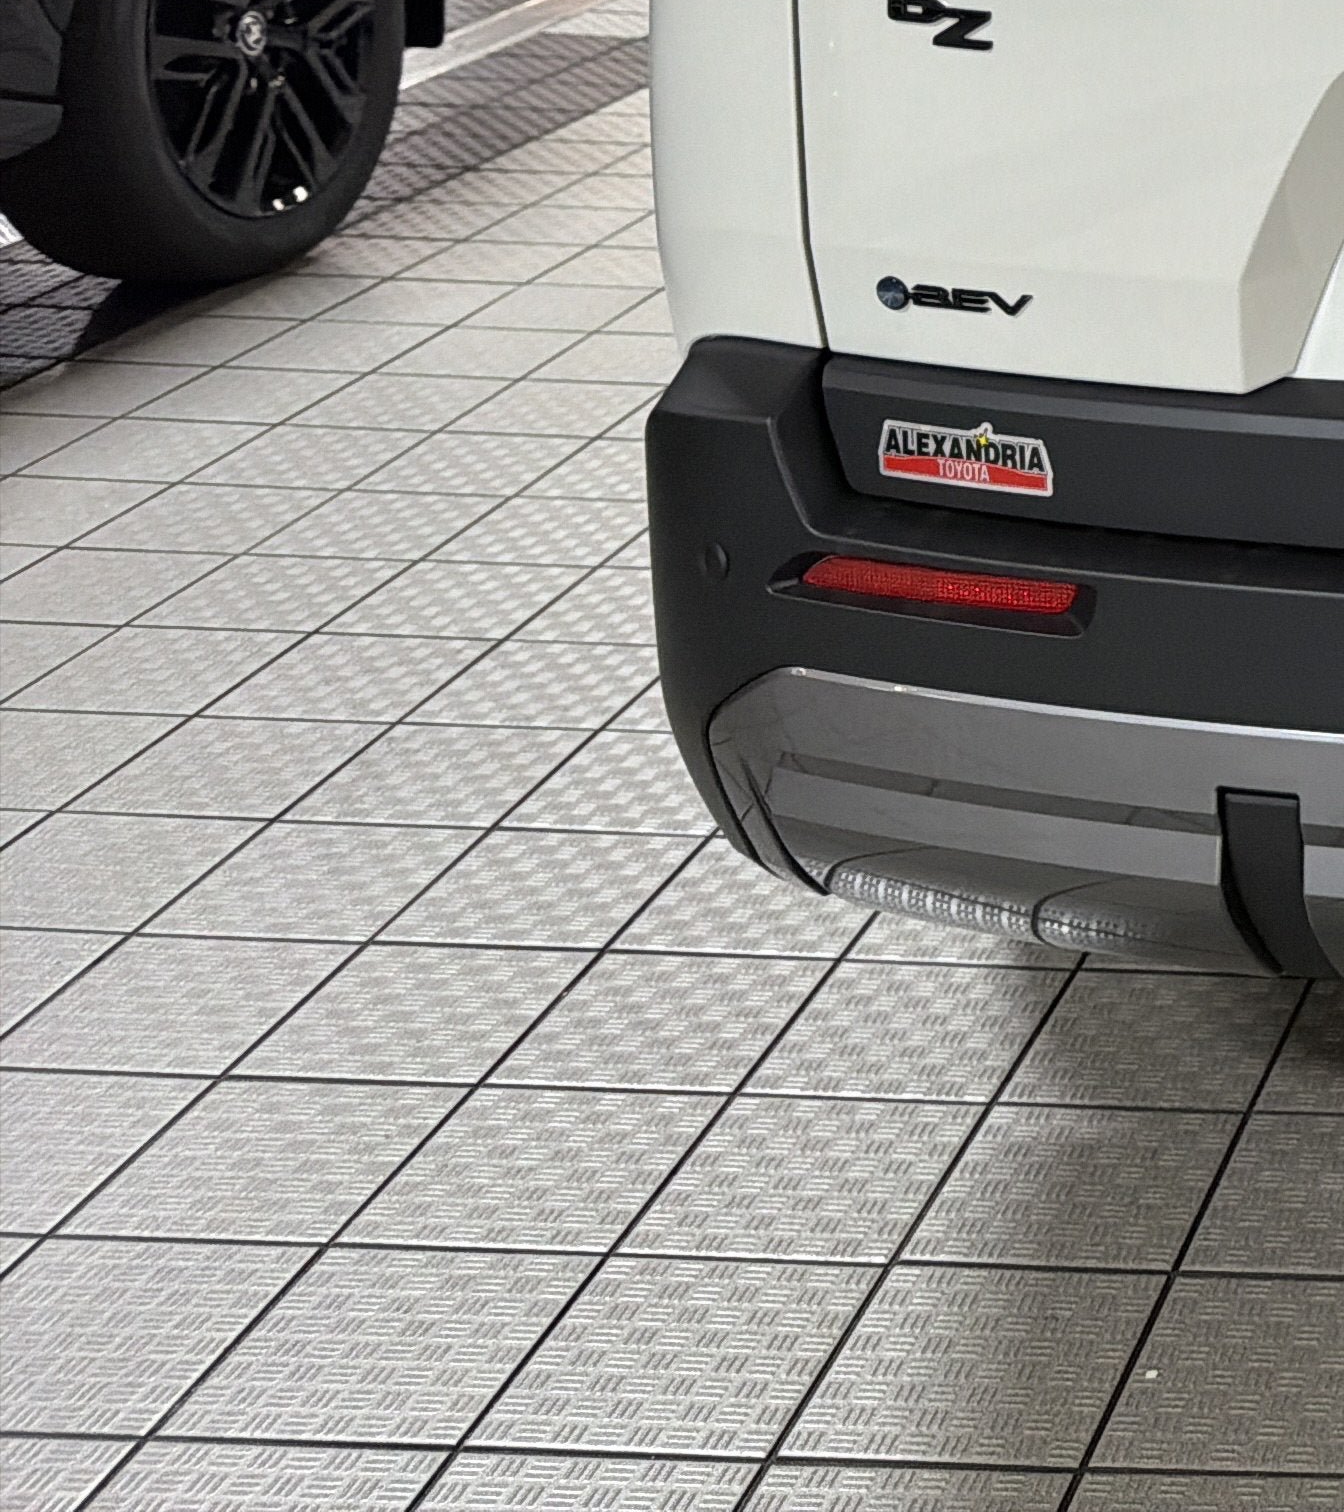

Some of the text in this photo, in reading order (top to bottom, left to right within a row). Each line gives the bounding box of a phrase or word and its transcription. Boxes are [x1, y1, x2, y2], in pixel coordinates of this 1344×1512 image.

[910, 283, 1034, 317] BEV
[885, 428, 1046, 473] ALEXANDRIA
[936, 459, 990, 482] TOYOTA
